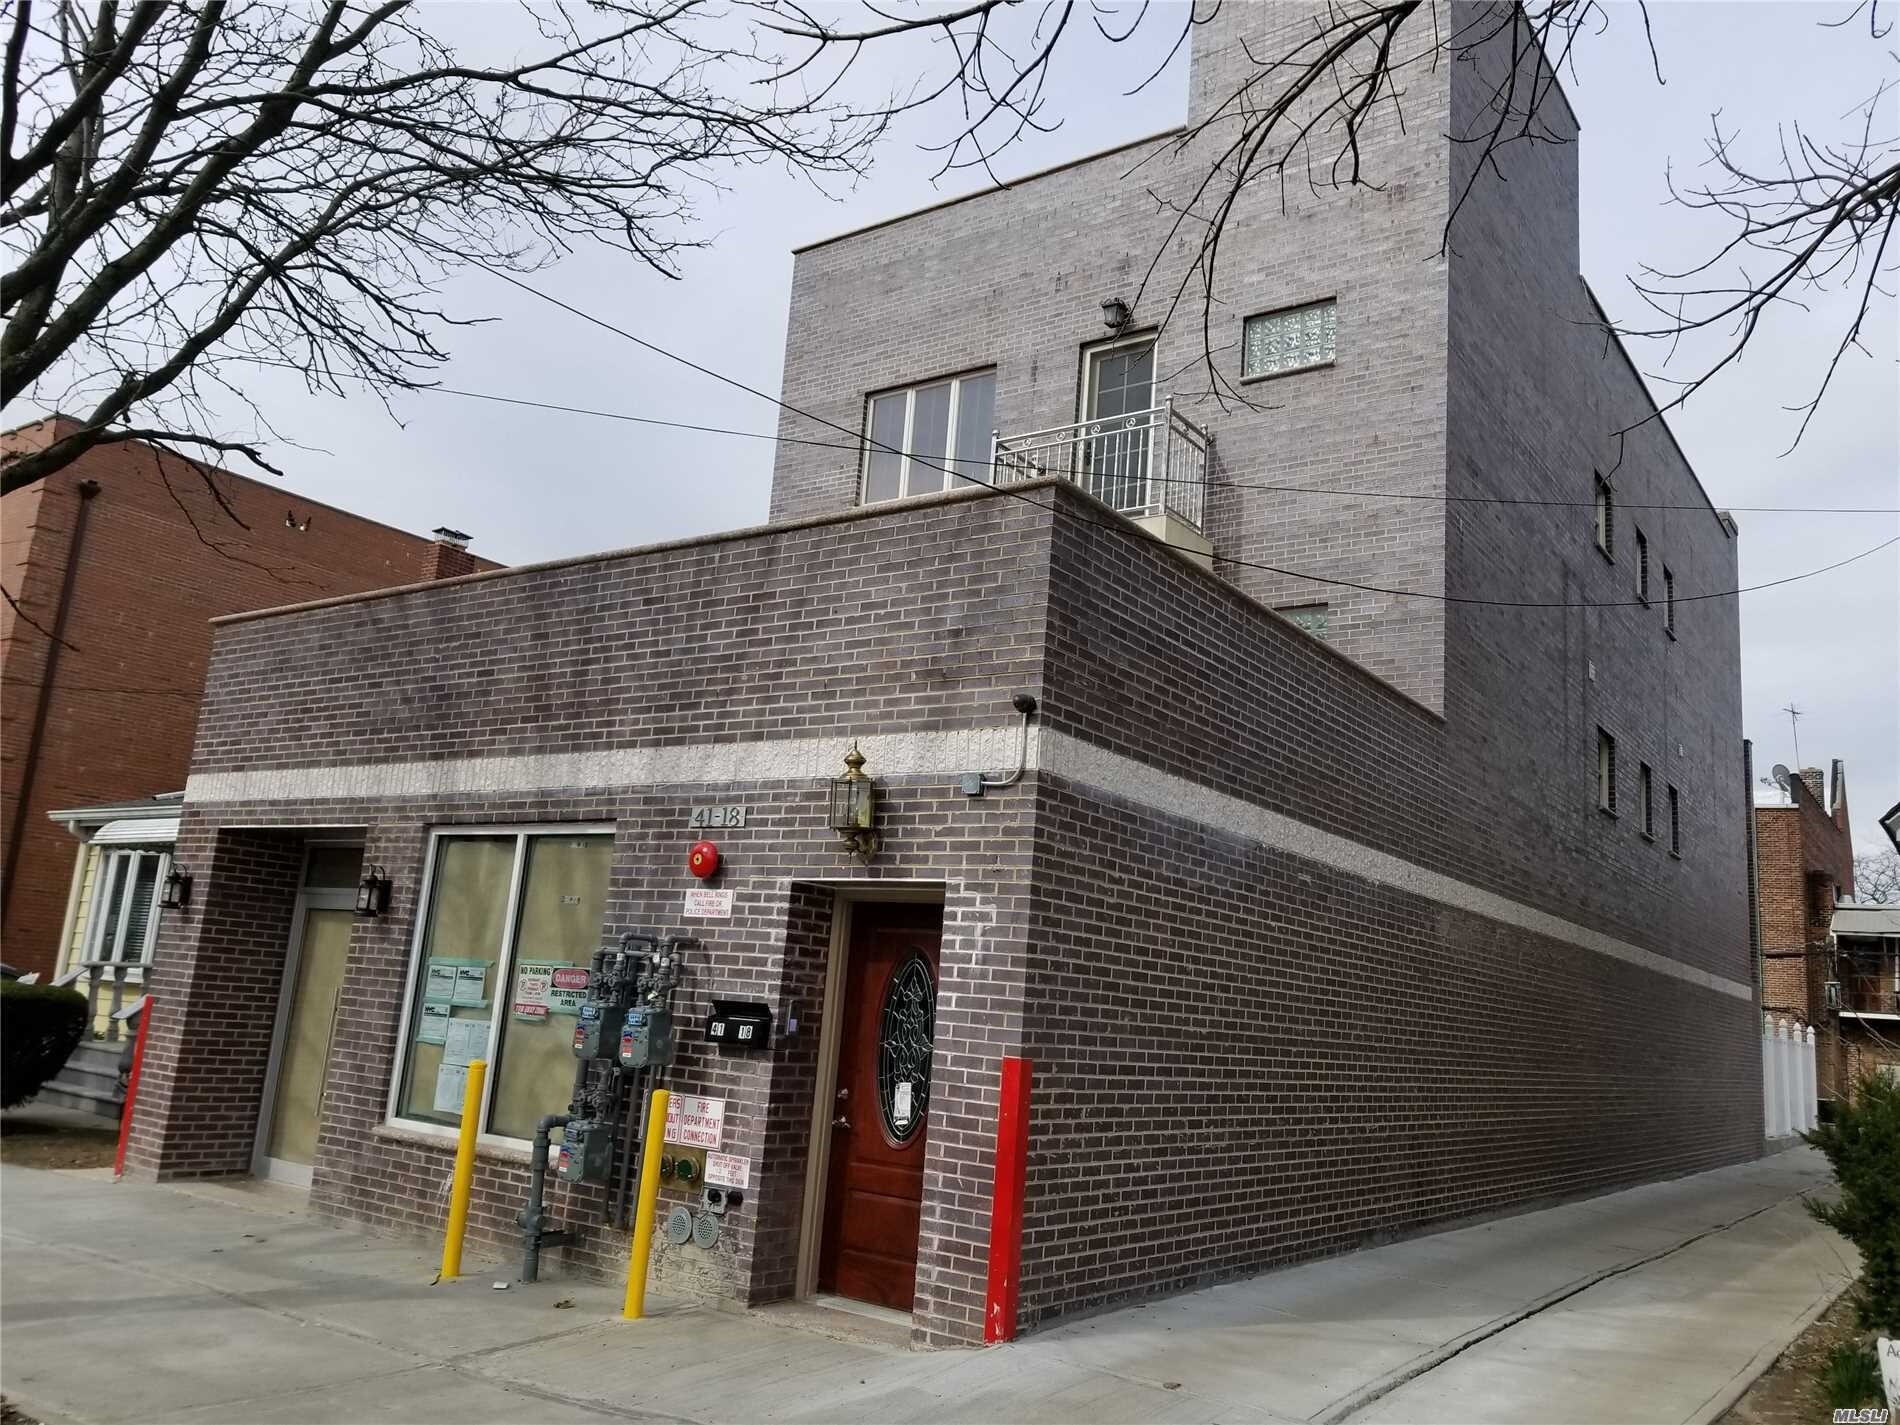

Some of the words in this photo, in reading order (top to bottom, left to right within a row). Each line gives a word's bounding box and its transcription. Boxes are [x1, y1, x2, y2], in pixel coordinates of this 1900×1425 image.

[695, 807, 740, 827] 41-18
[521, 966, 528, 975] NO
[529, 967, 551, 976] PARKING
[555, 971, 587, 984] DANGER
[551, 989, 587, 999] RESTRICTED
[560, 999, 577, 1007] AREA
[711, 1022, 725, 1036] 41
[739, 1025, 753, 1039] 18
[696, 1101, 710, 1114] FIRE
[683, 1114, 720, 1130] DEPARTMENT
[683, 1131, 717, 1146] CONNECTION
